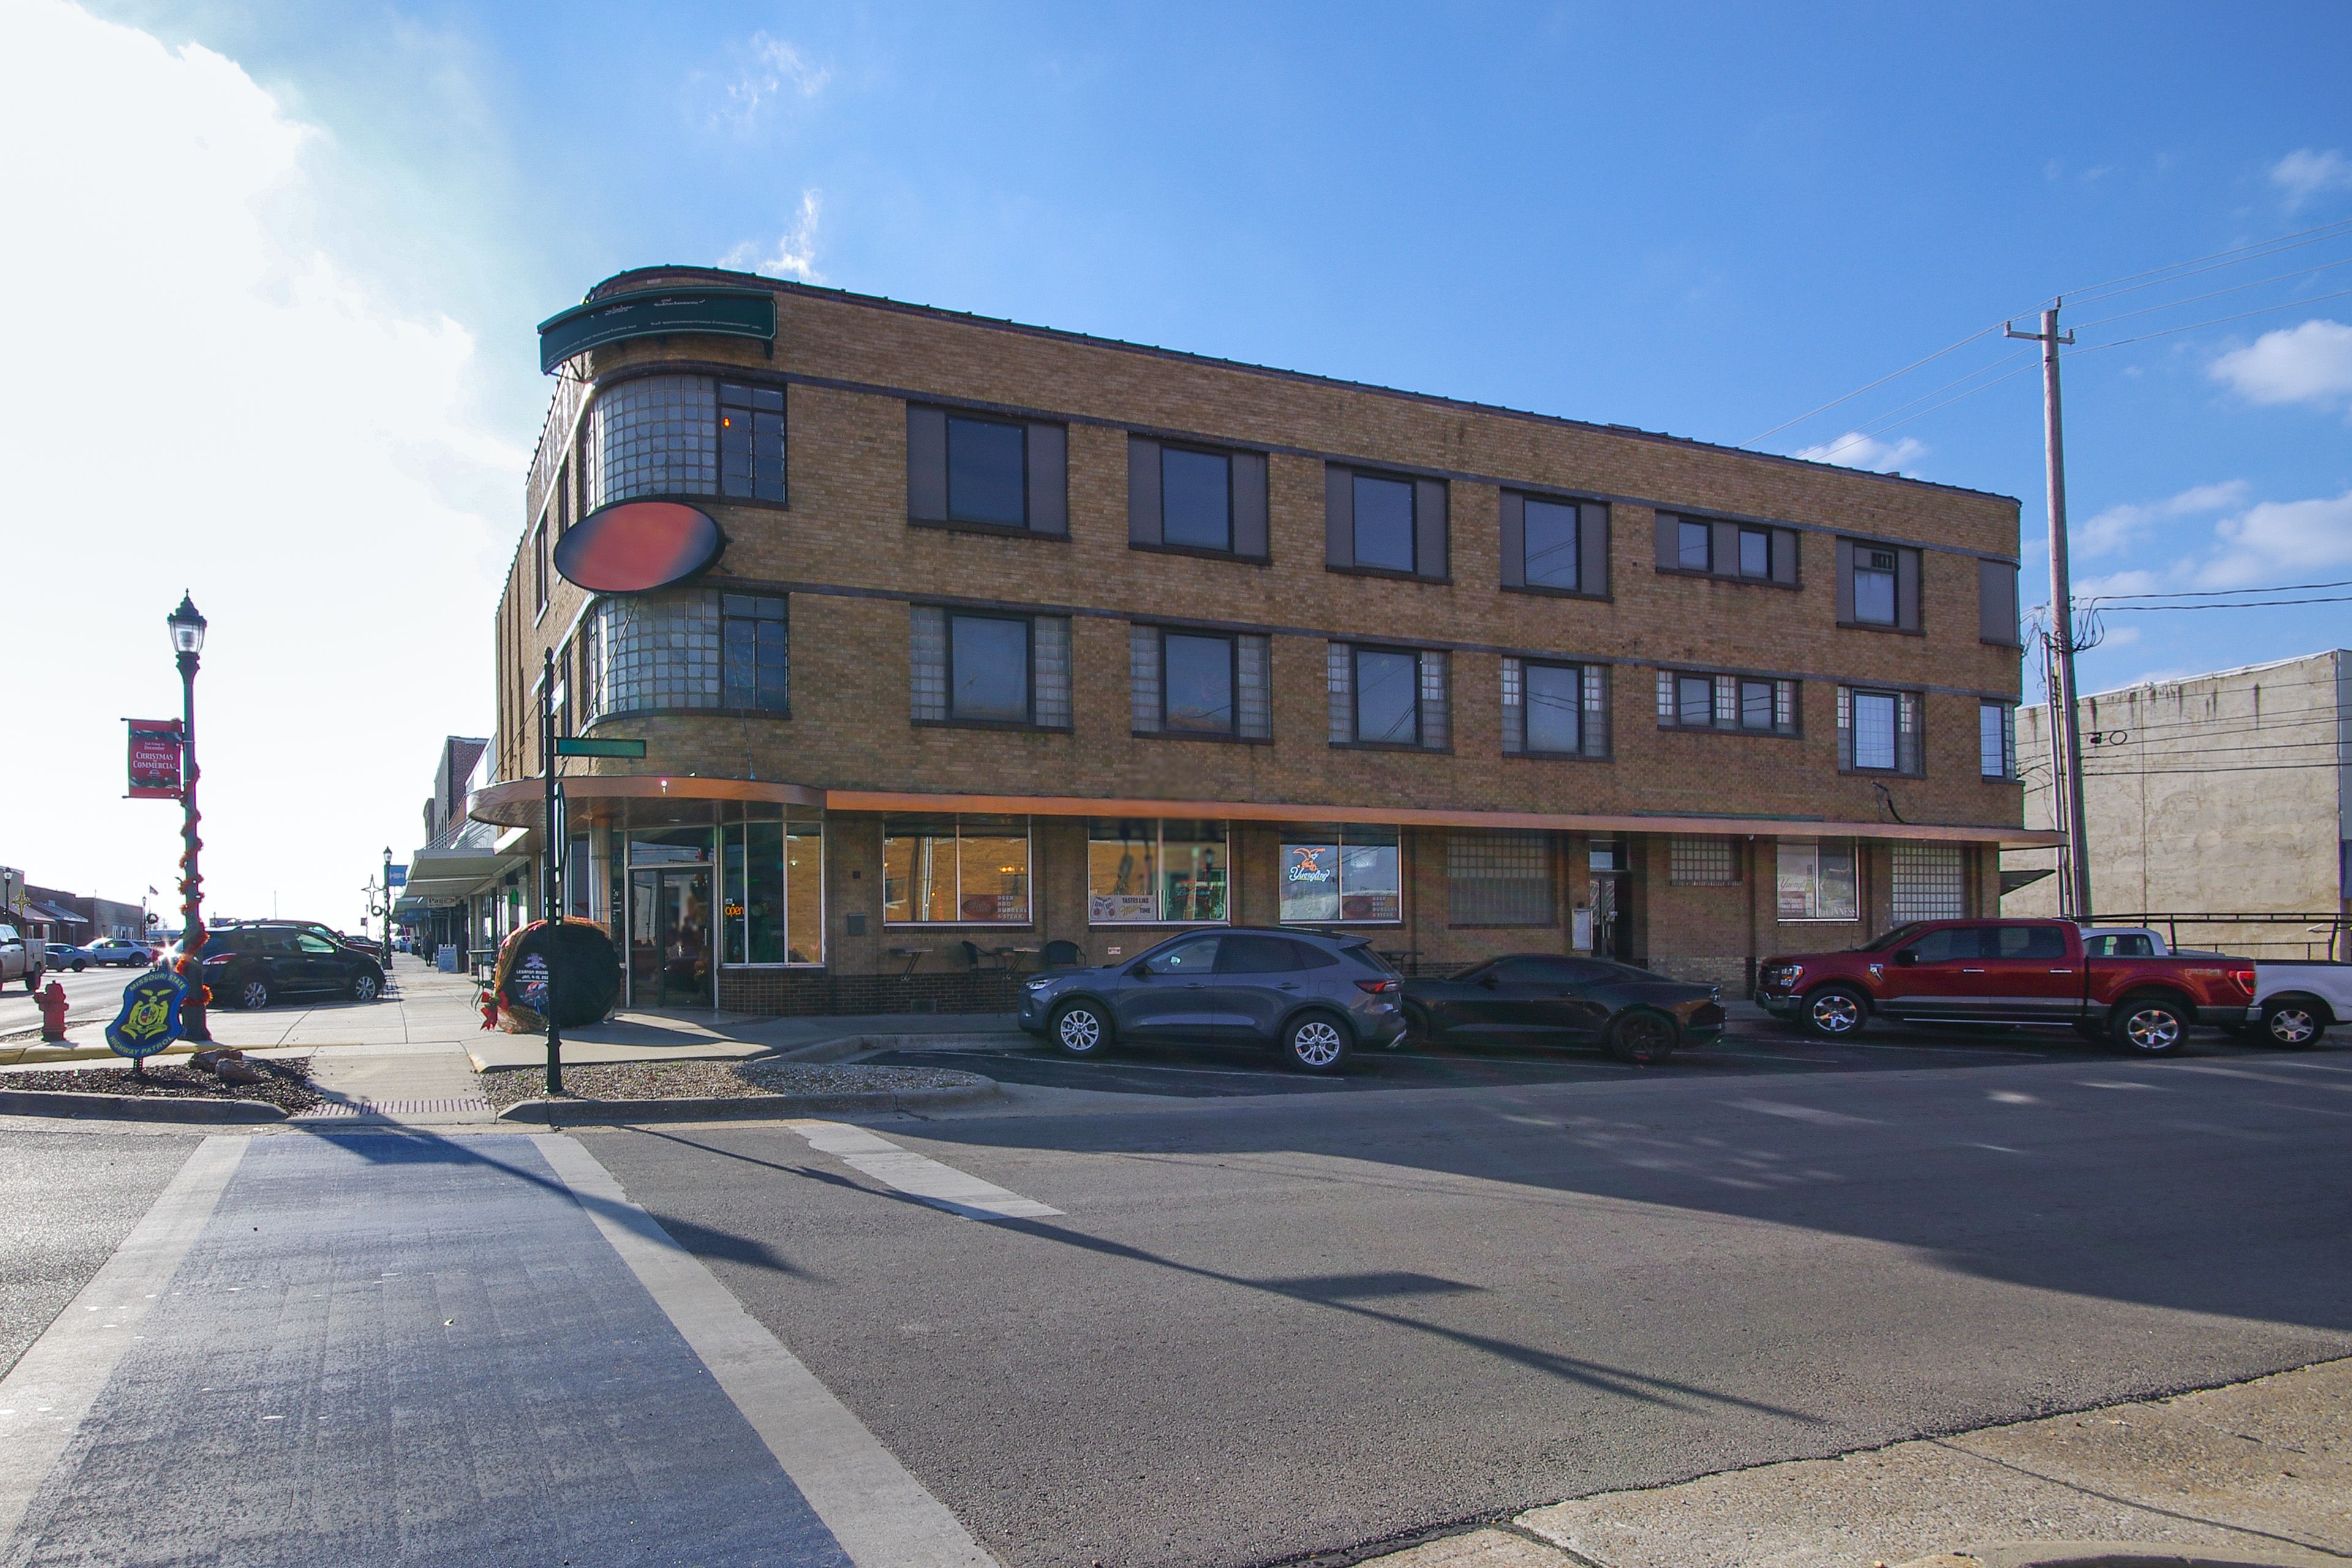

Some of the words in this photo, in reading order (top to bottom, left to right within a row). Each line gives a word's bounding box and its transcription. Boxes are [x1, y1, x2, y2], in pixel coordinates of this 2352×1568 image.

[136, 751, 174, 760] CHRISTMAS
[1289, 867, 1330, 882] Yuengling
[1819, 907, 1855, 917] GUINNESS
[129, 973, 167, 990] MISSOURI
[168, 974, 186, 990] STATE
[110, 1035, 139, 1054] HIGHWAY
[141, 1036, 173, 1054] PATROL
